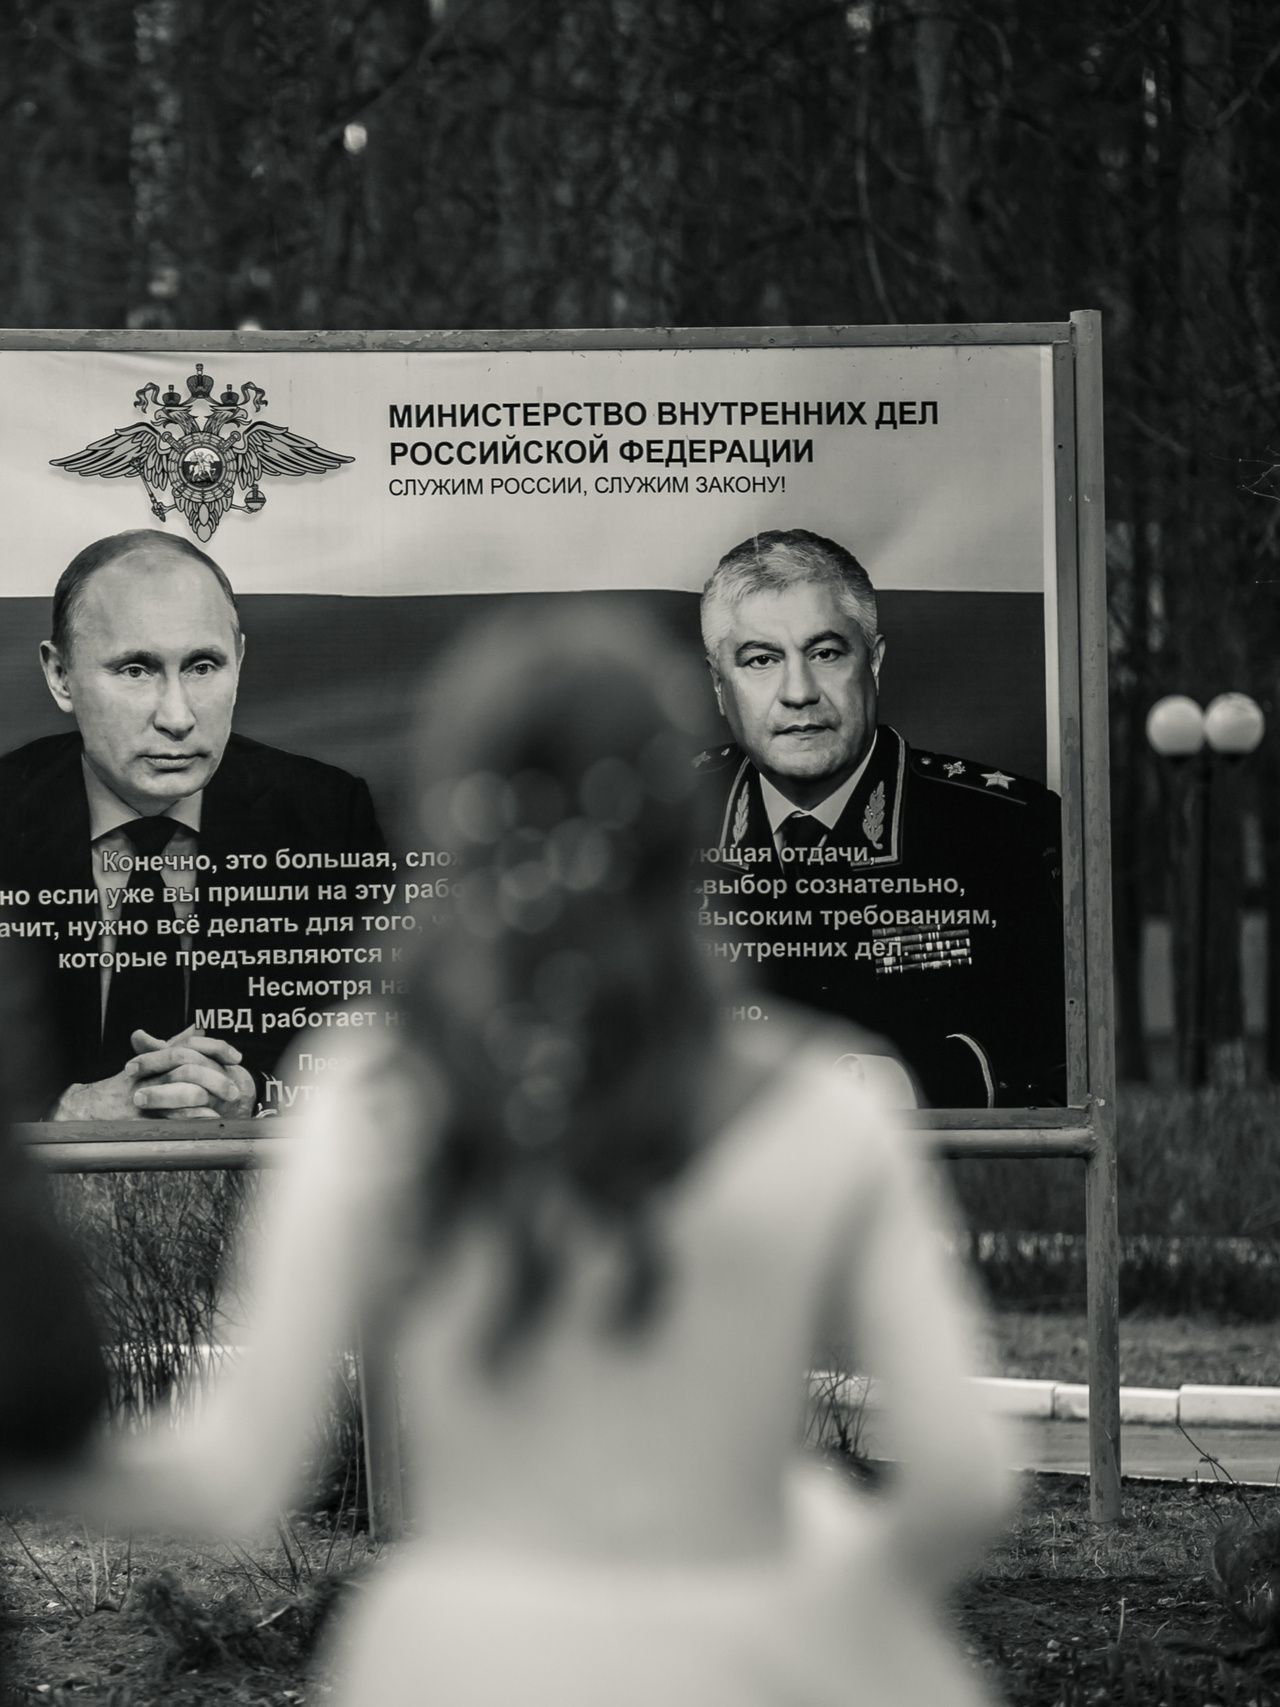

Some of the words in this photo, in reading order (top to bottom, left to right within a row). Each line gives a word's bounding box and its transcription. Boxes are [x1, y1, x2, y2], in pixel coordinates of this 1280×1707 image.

[389, 402, 647, 428] МИНИСТЕРСТВО
[657, 400, 867, 426] ВНУТРЕННИХ
[875, 400, 940, 430] ДЕЛ
[390, 433, 609, 466] РОССИЙСКОЙ
[619, 438, 814, 468] ФЕДЕРАЦИИ
[388, 478, 483, 496] СЛУЖИМ
[491, 477, 588, 498] РОССИИ,
[595, 476, 689, 495] СЛУЖИМ
[696, 475, 786, 494] ЗАКОНУ!
[102, 850, 218, 875] Конечно,
[225, 852, 267, 870] это
[275, 848, 397, 873] большая,
[780, 844, 875, 864] отдачи,
[0, 889, 30, 906] но
[38, 888, 99, 905] если
[107, 887, 154, 909] уже
[162, 885, 201, 903] вы
[208, 883, 311, 906] пришли
[318, 883, 348, 900] на
[355, 883, 396, 904] эту
[703, 873, 788, 899] выбор
[795, 876, 966, 897] сознательно,
[68, 918, 149, 941] нужно
[157, 915, 201, 936] всё
[207, 914, 298, 937] делать
[305, 915, 355, 935] для
[361, 913, 423, 934] того,
[698, 909, 813, 926] высоким
[820, 904, 998, 929] требованиям,
[58, 950, 167, 972] которые
[175, 945, 383, 971] предъявляются
[855, 940, 910, 962] дел.
[248, 975, 372, 999] Несмотря
[195, 1008, 254, 1033] МВД
[261, 1006, 377, 1033] работает
